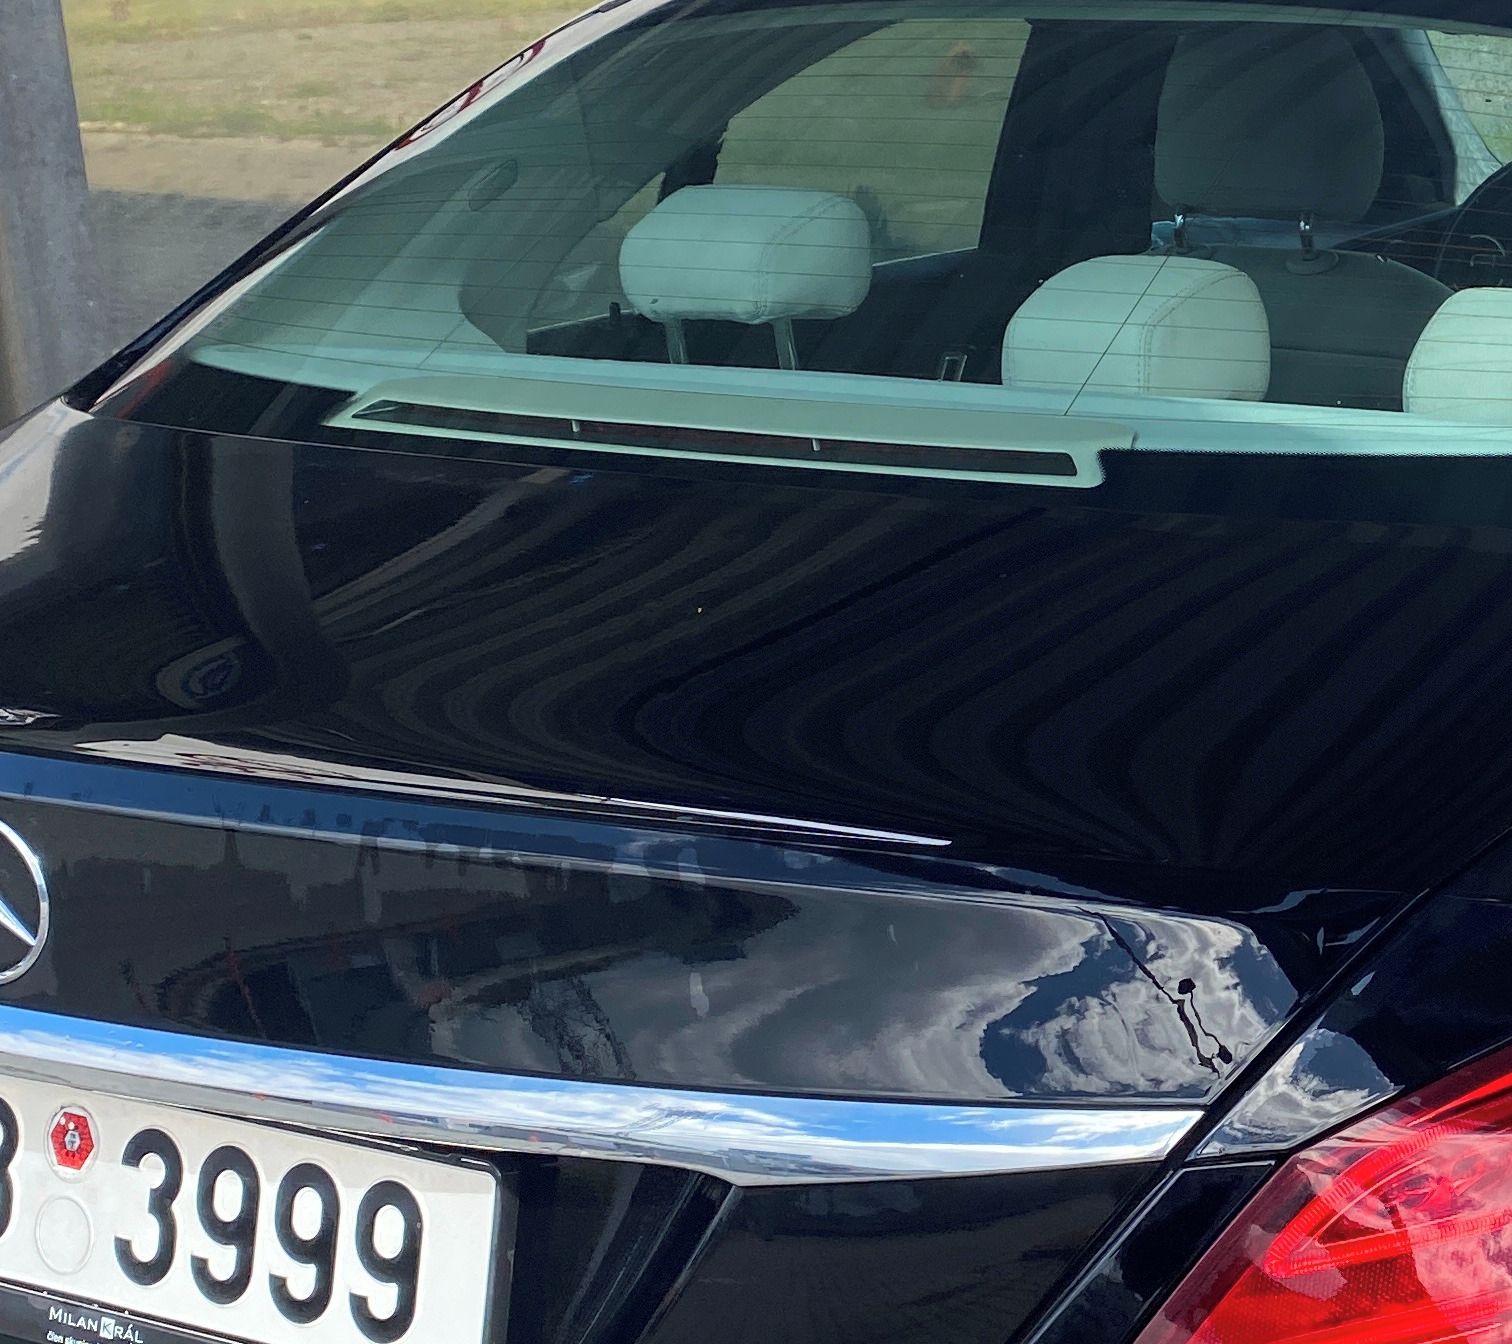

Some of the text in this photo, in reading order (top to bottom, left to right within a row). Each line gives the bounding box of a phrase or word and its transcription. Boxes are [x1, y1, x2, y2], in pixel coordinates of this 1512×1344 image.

[113, 1128, 423, 1344] 3999
[49, 1306, 144, 1344] MILAN KRÁL
